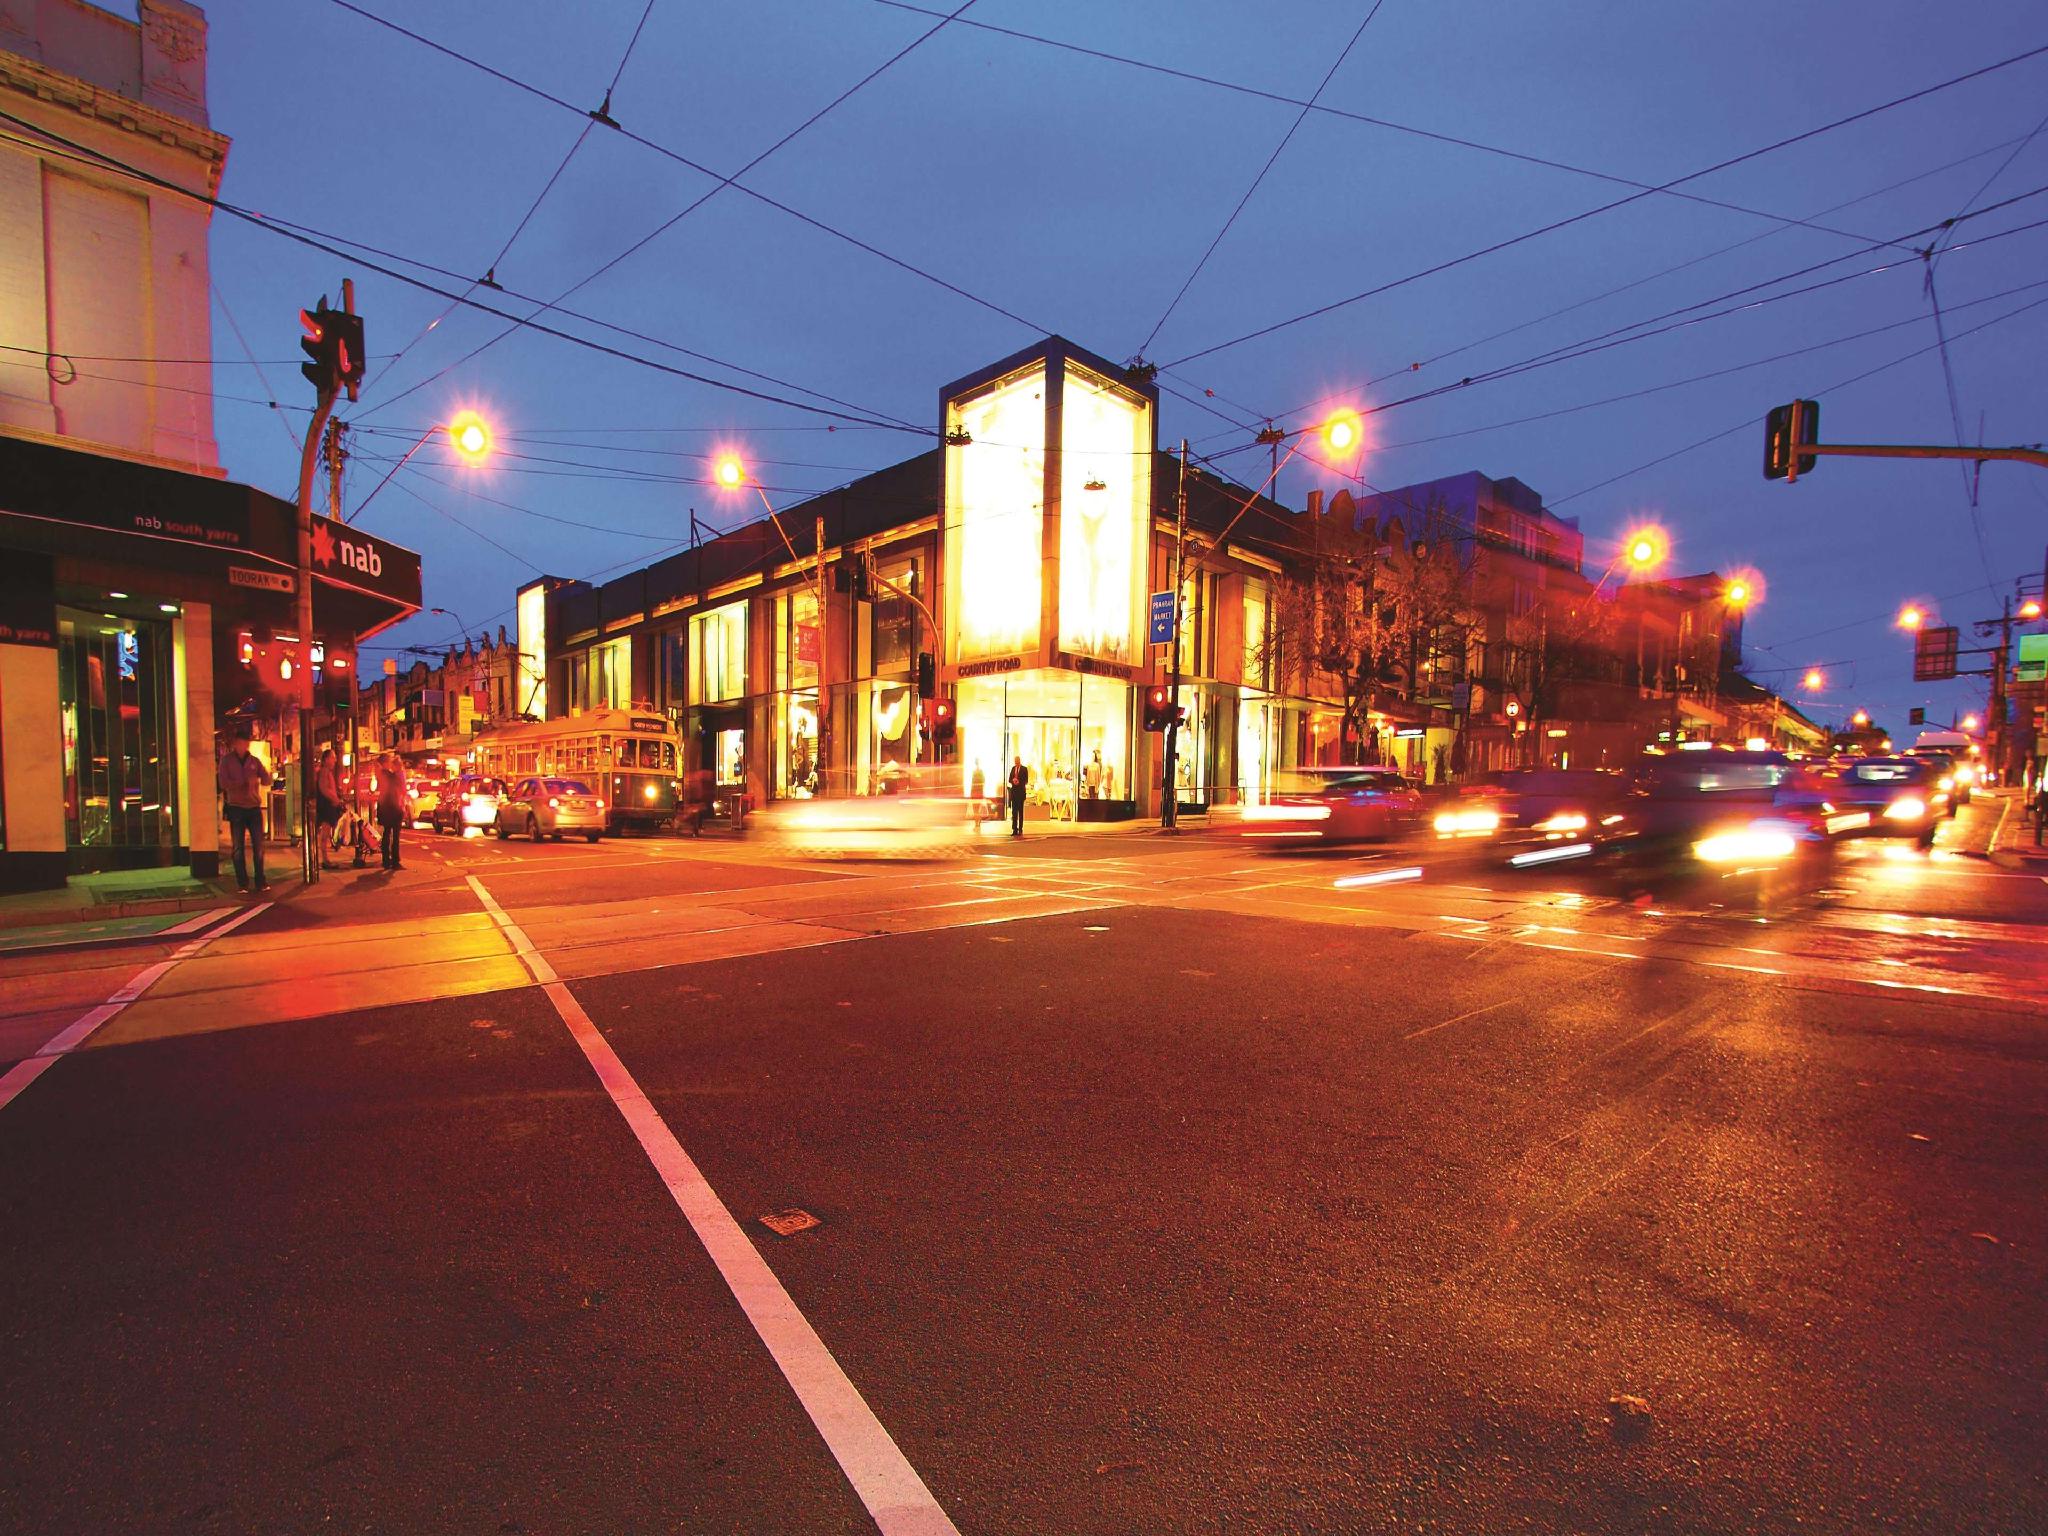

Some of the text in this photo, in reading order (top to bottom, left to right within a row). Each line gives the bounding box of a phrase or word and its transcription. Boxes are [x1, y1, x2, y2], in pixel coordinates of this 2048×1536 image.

[135, 515, 240, 543] nab south yarra
[340, 540, 382, 577] nab
[231, 570, 271, 587] TOORAK
[1153, 611, 1172, 621] MARKET
[958, 657, 1021, 677] COUNTRY ROAD
